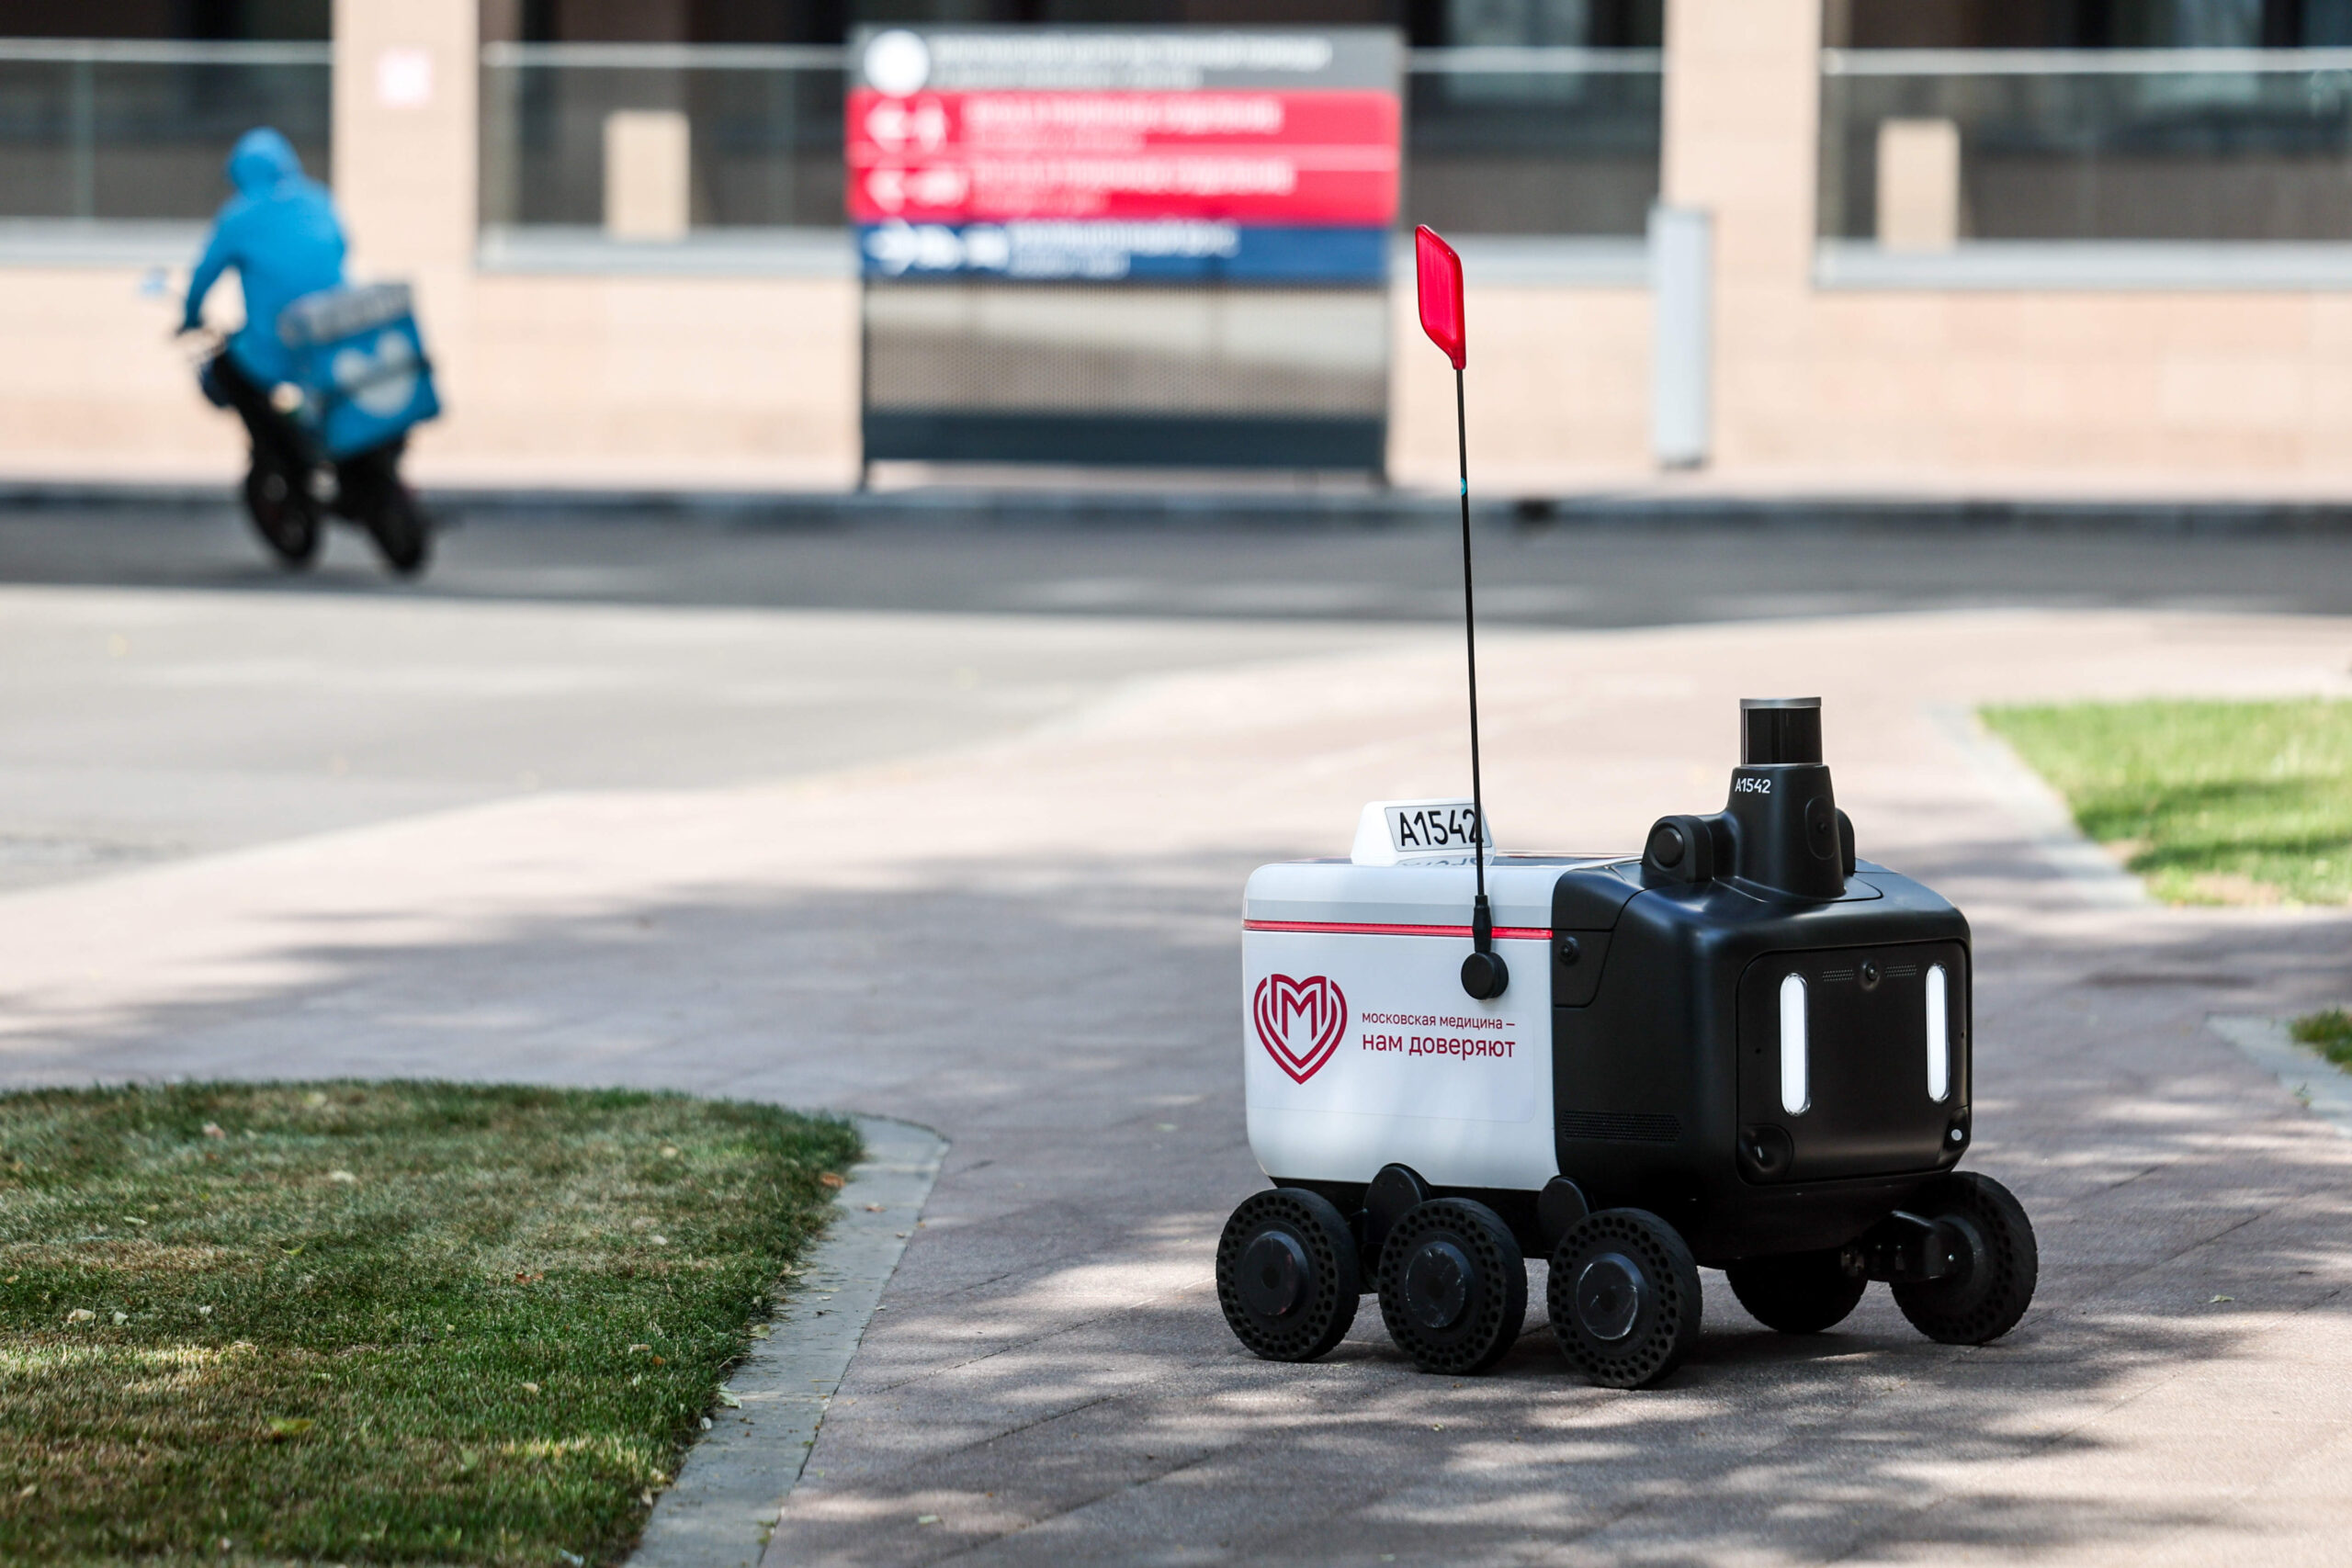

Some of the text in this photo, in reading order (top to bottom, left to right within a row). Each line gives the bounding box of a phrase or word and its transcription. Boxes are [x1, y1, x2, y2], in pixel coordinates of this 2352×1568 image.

[1734, 777, 1772, 794] A1542
[1362, 1012, 1437, 1027] московская
[1439, 1016, 1503, 1031] медицина
[1363, 1033, 1516, 1061] нам доверяют
